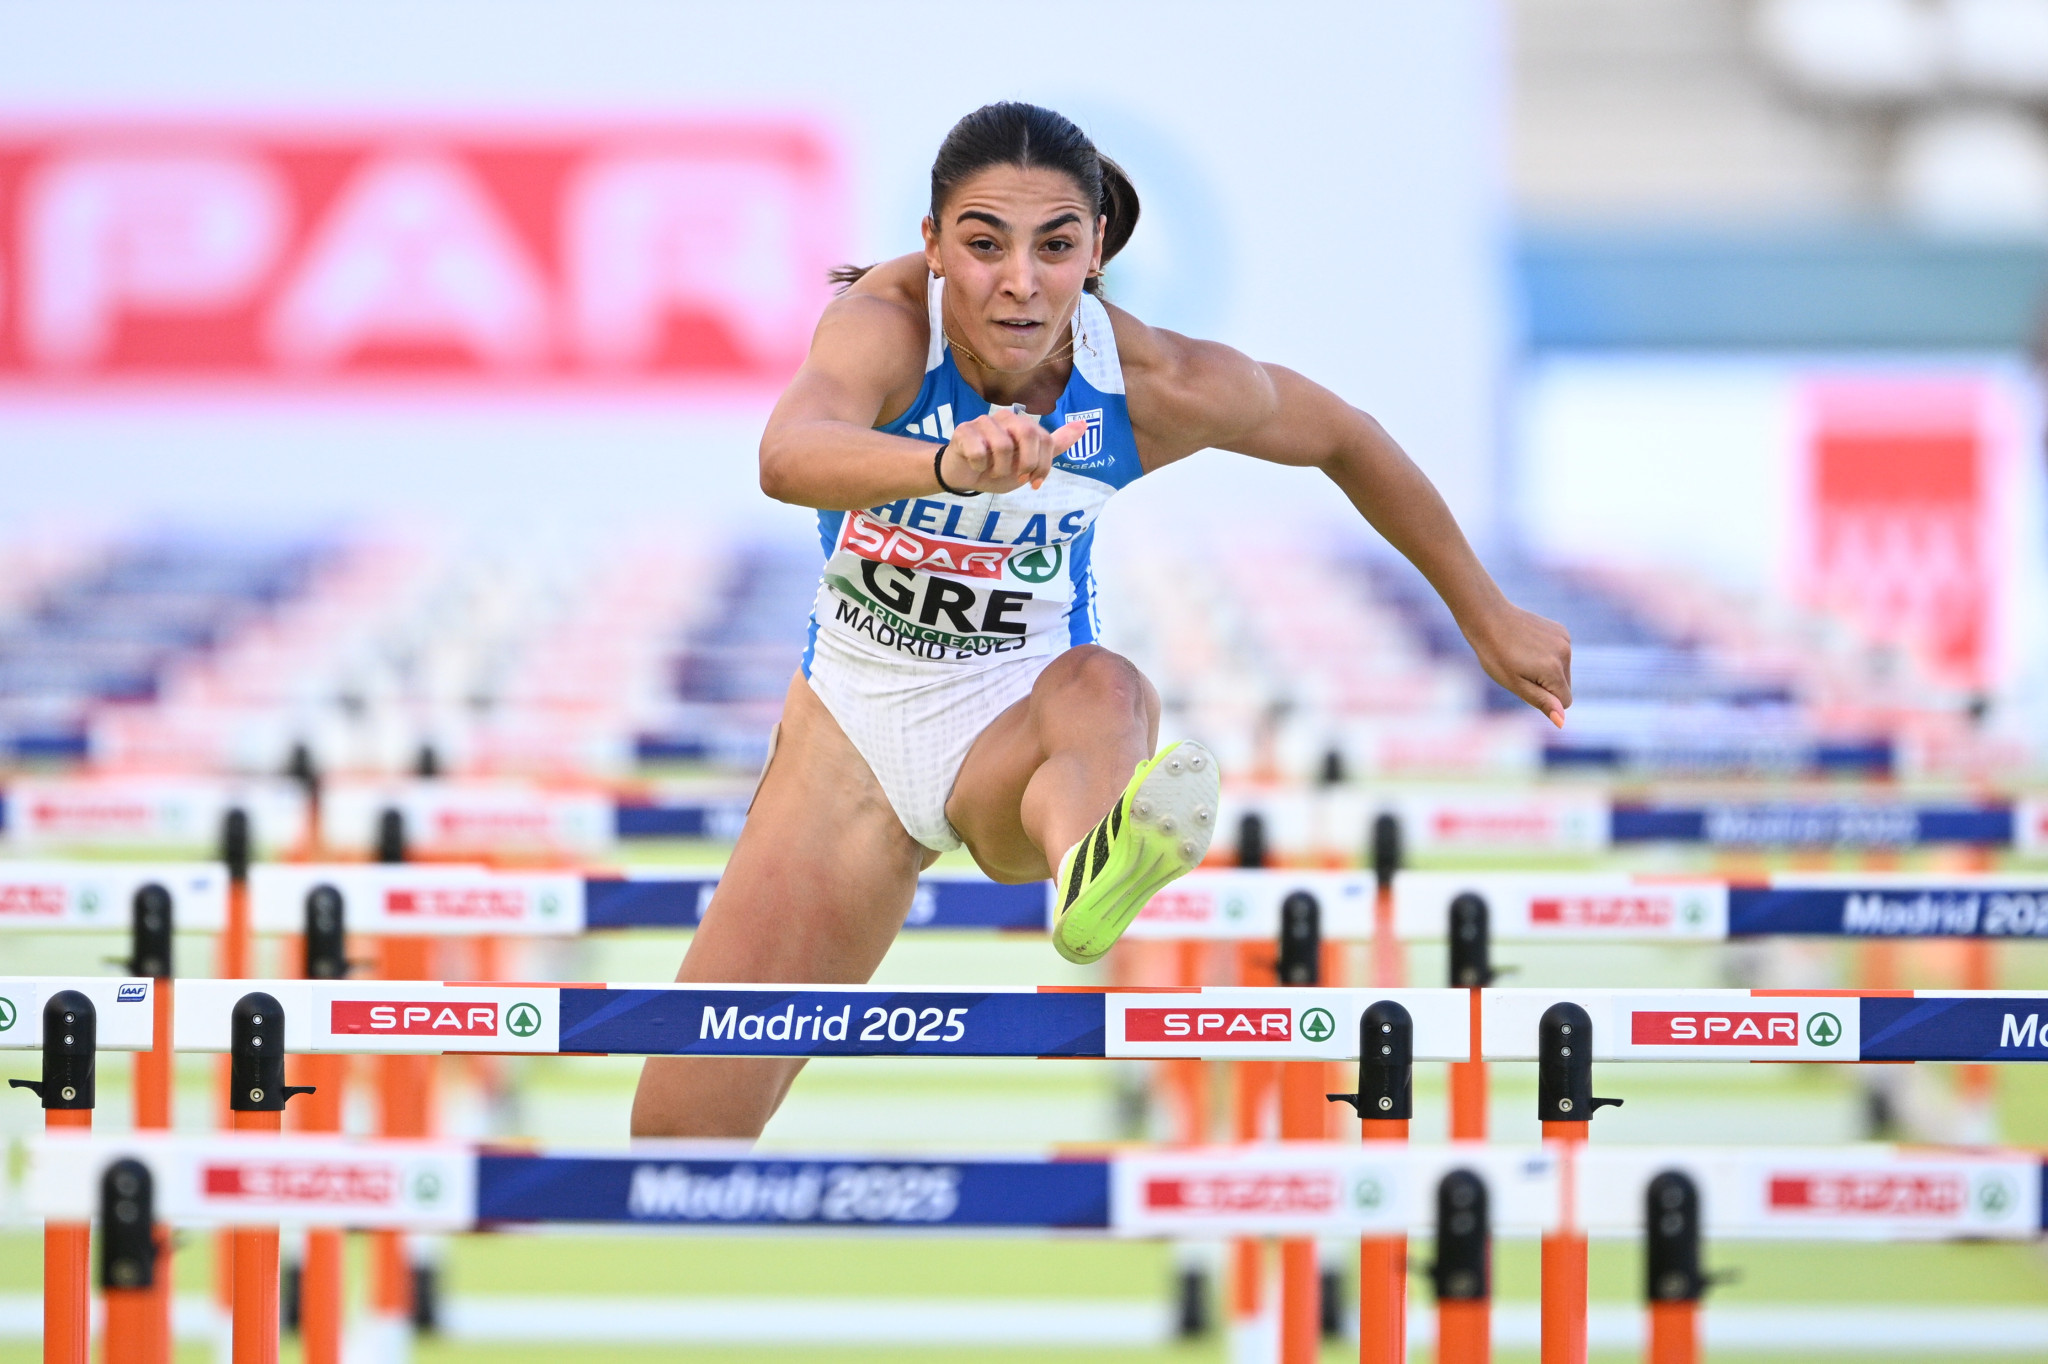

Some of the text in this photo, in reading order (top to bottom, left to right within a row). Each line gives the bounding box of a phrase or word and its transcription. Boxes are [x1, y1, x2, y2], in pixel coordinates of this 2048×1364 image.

[0, 145, 808, 370] PAR
[1052, 459, 1105, 470] AEGEAN
[870, 498, 1085, 547] HELLAS
[848, 513, 1004, 572] SPAR
[861, 559, 1034, 635] GRE
[835, 599, 946, 660] MADRID
[873, 605, 917, 637] RUN
[370, 1006, 494, 1030] SPAR
[700, 1004, 968, 1042] Madrid 2025
[1164, 1013, 1288, 1036] SPAR
[1670, 1017, 1795, 1040] SPAR
